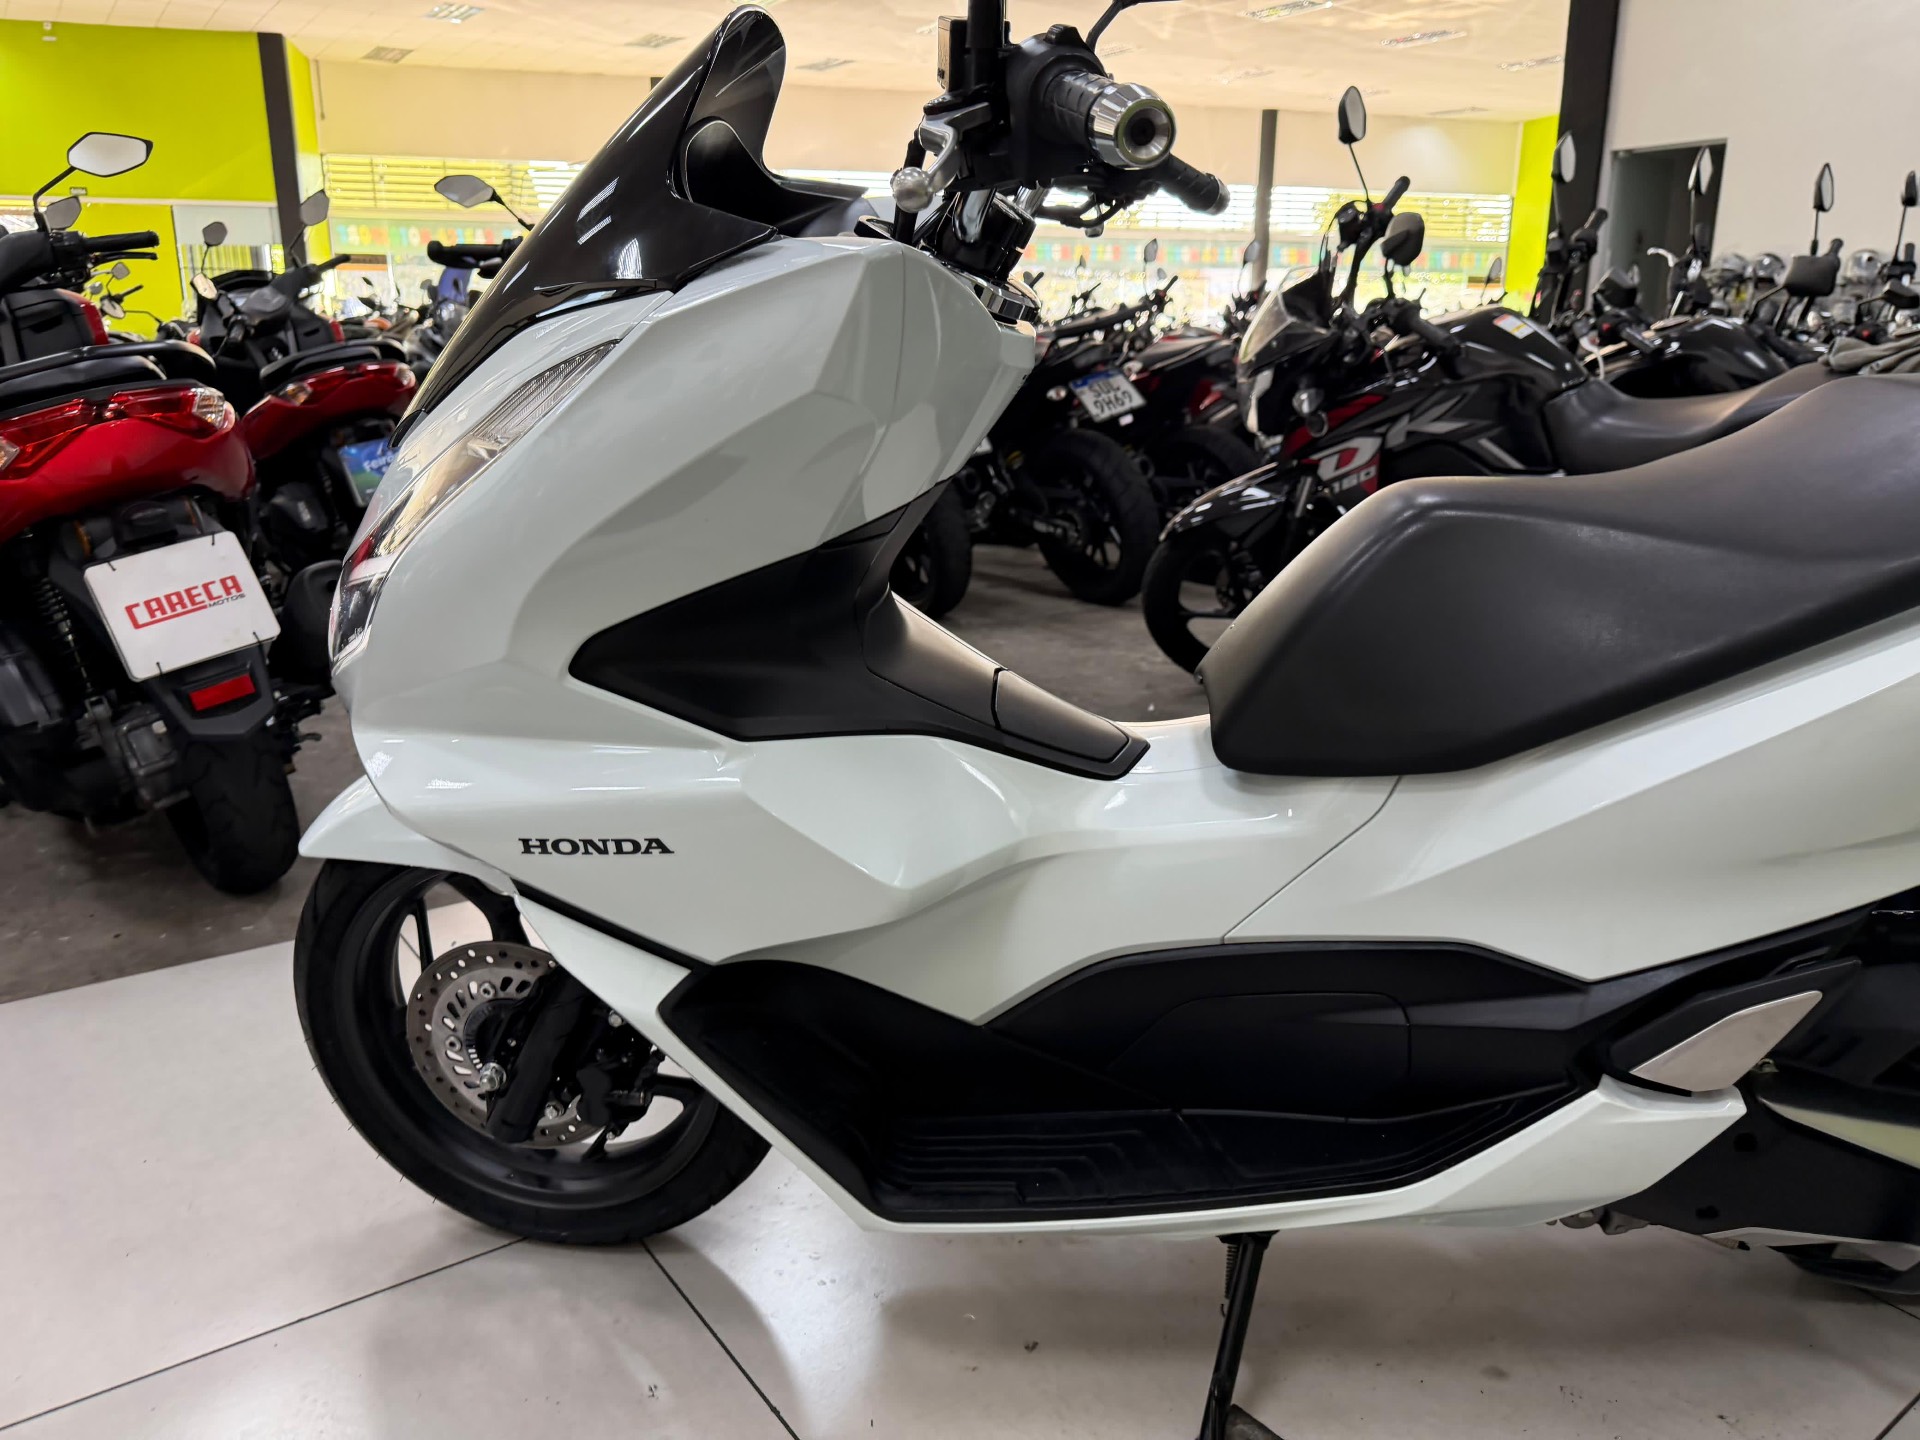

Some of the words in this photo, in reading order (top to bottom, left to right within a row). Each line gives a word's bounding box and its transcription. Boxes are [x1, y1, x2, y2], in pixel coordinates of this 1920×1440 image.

[124, 574, 244, 630] CARECA
[208, 592, 247, 608] MOTOS
[518, 837, 675, 856] HONDA
